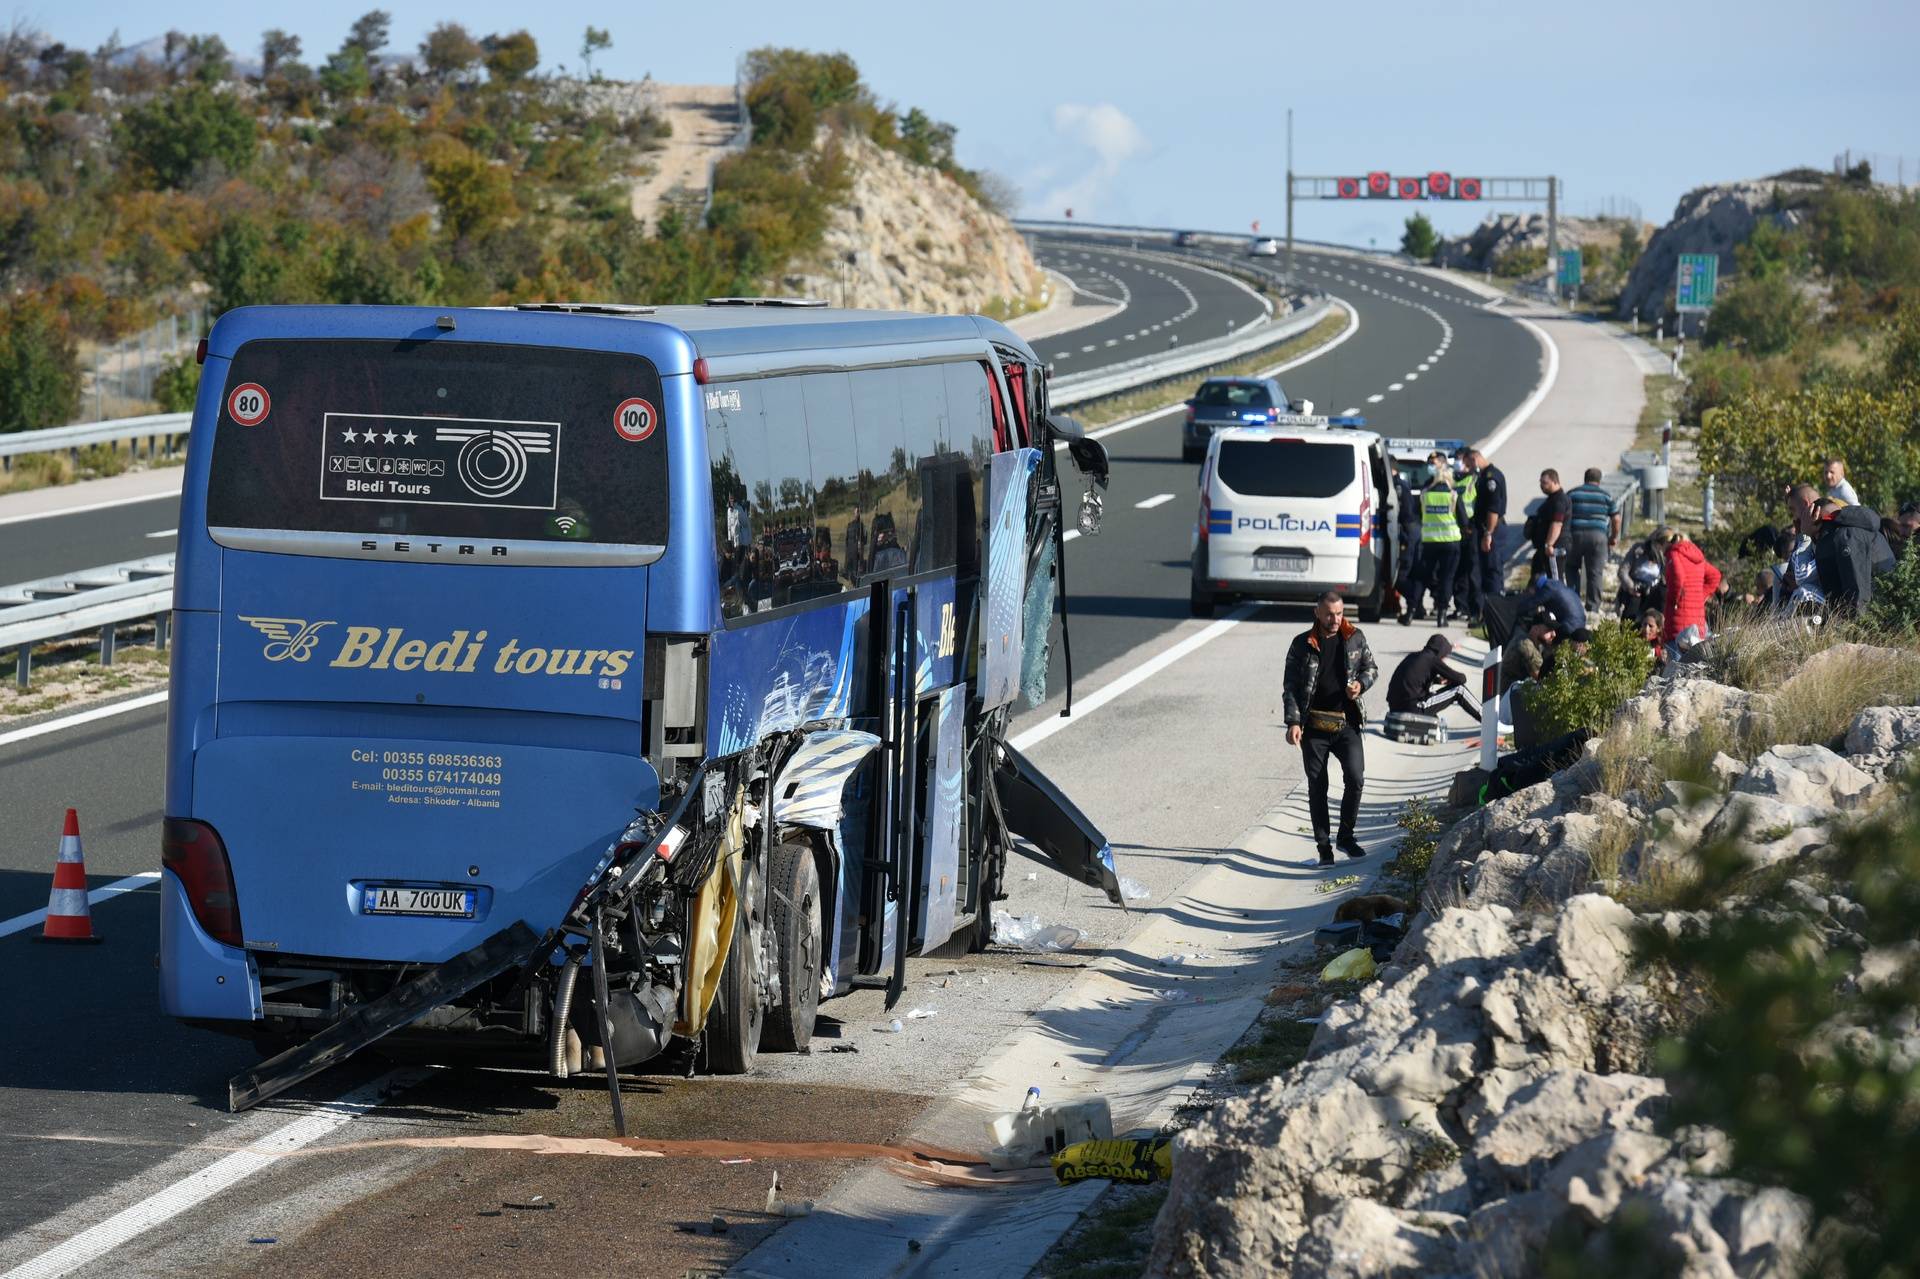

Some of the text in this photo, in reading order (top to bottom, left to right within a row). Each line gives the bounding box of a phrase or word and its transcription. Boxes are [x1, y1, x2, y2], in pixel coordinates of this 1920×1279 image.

[239, 396, 259, 412] 80
[623, 410, 648, 428] 100
[1279, 416, 1327, 424] POLICIJA
[413, 463, 426, 472] WC
[346, 480, 431, 495] Bledi Tours
[1237, 514, 1332, 532] POLICIJA
[361, 541, 508, 556] SETRA
[329, 626, 634, 677] Bledi tours
[351, 750, 502, 769] Cel: 00355 698536363
[382, 767, 501, 785] 00355 674174049
[351, 781, 500, 797] E-mail: bleditours@hotmail.com
[388, 795, 422, 805] Adresa:
[423, 796, 460, 807] Shkoder
[467, 798, 500, 809] Albania
[379, 890, 400, 908] AA
[1063, 1164, 1149, 1180] ABSODAN
